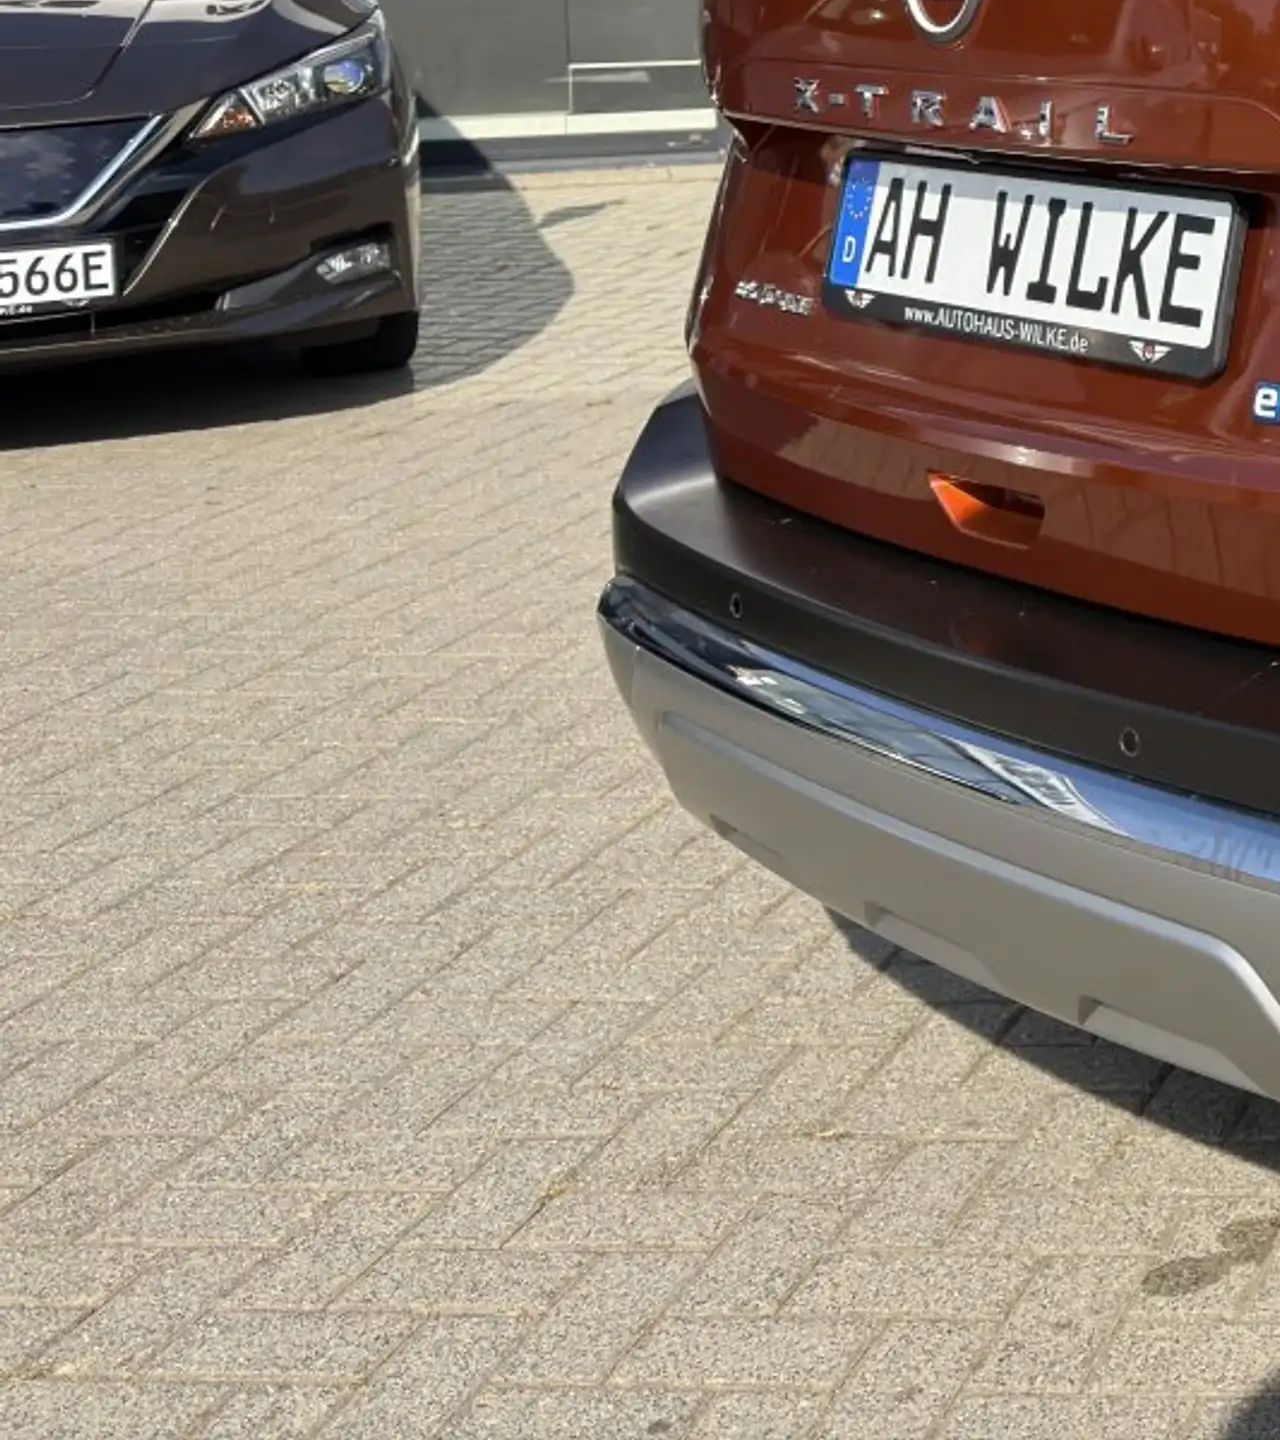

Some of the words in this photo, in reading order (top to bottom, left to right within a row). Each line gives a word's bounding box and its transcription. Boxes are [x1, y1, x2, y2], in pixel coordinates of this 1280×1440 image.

[794, 76, 1134, 146] X-TRAIL
[842, 235, 856, 263] D
[865, 177, 953, 284] AH
[985, 189, 1216, 329] WILKE
[0, 250, 110, 299] 566E
[904, 306, 1089, 354] www.AUTOHAUS-WILKE.de
